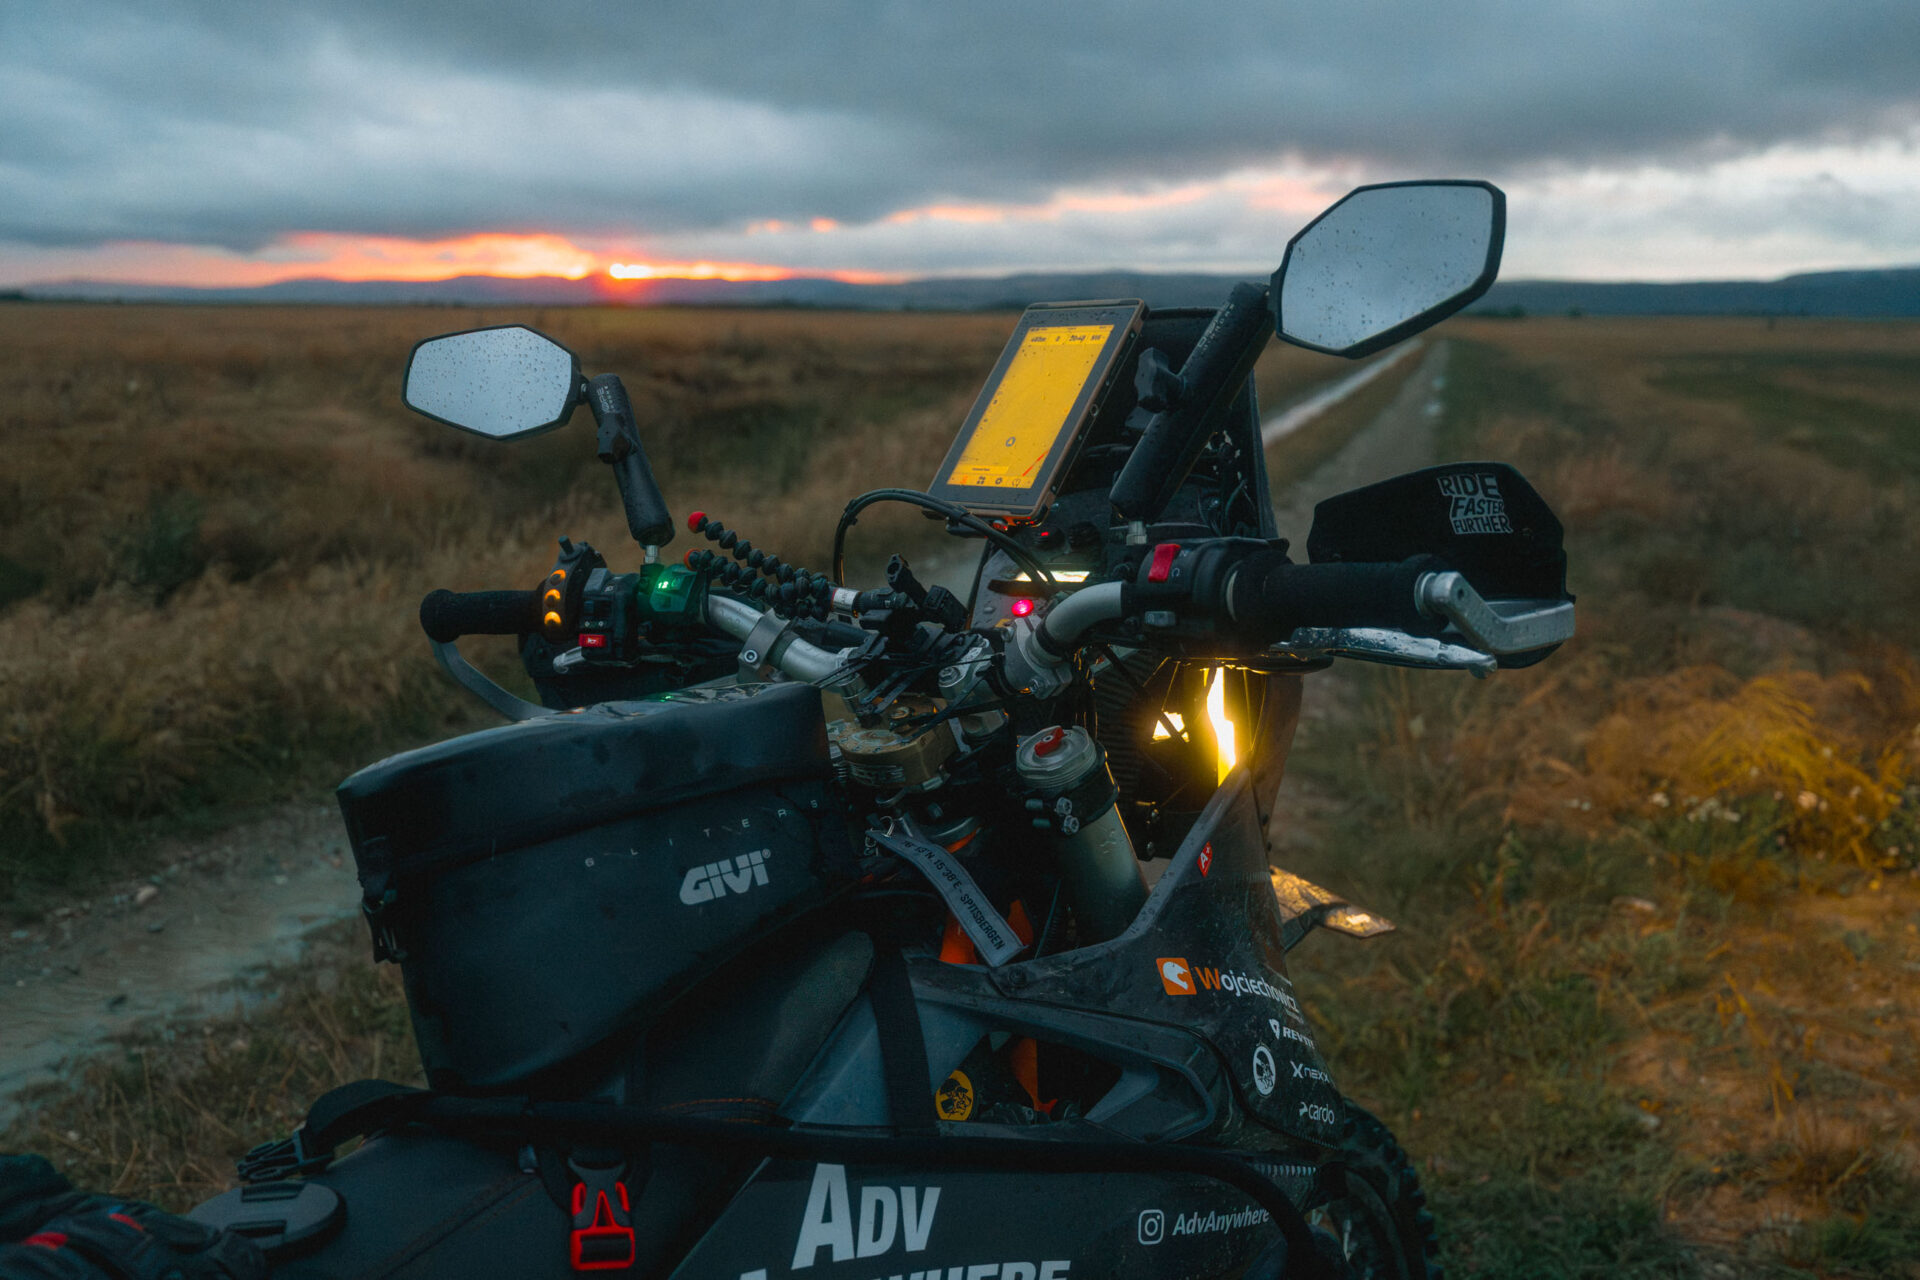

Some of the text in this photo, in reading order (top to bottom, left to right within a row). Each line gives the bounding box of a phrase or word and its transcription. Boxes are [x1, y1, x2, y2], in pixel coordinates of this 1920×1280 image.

[1438, 474, 1500, 499] RIDE
[1451, 497, 1504, 518] FASTER
[1453, 516, 1512, 534] FURTHER
[679, 850, 769, 905] GIVI
[960, 893, 1005, 950] SPITSBERGEN
[1308, 1102, 1335, 1125] cardo
[1172, 1204, 1270, 1236] AdvAnywhere
